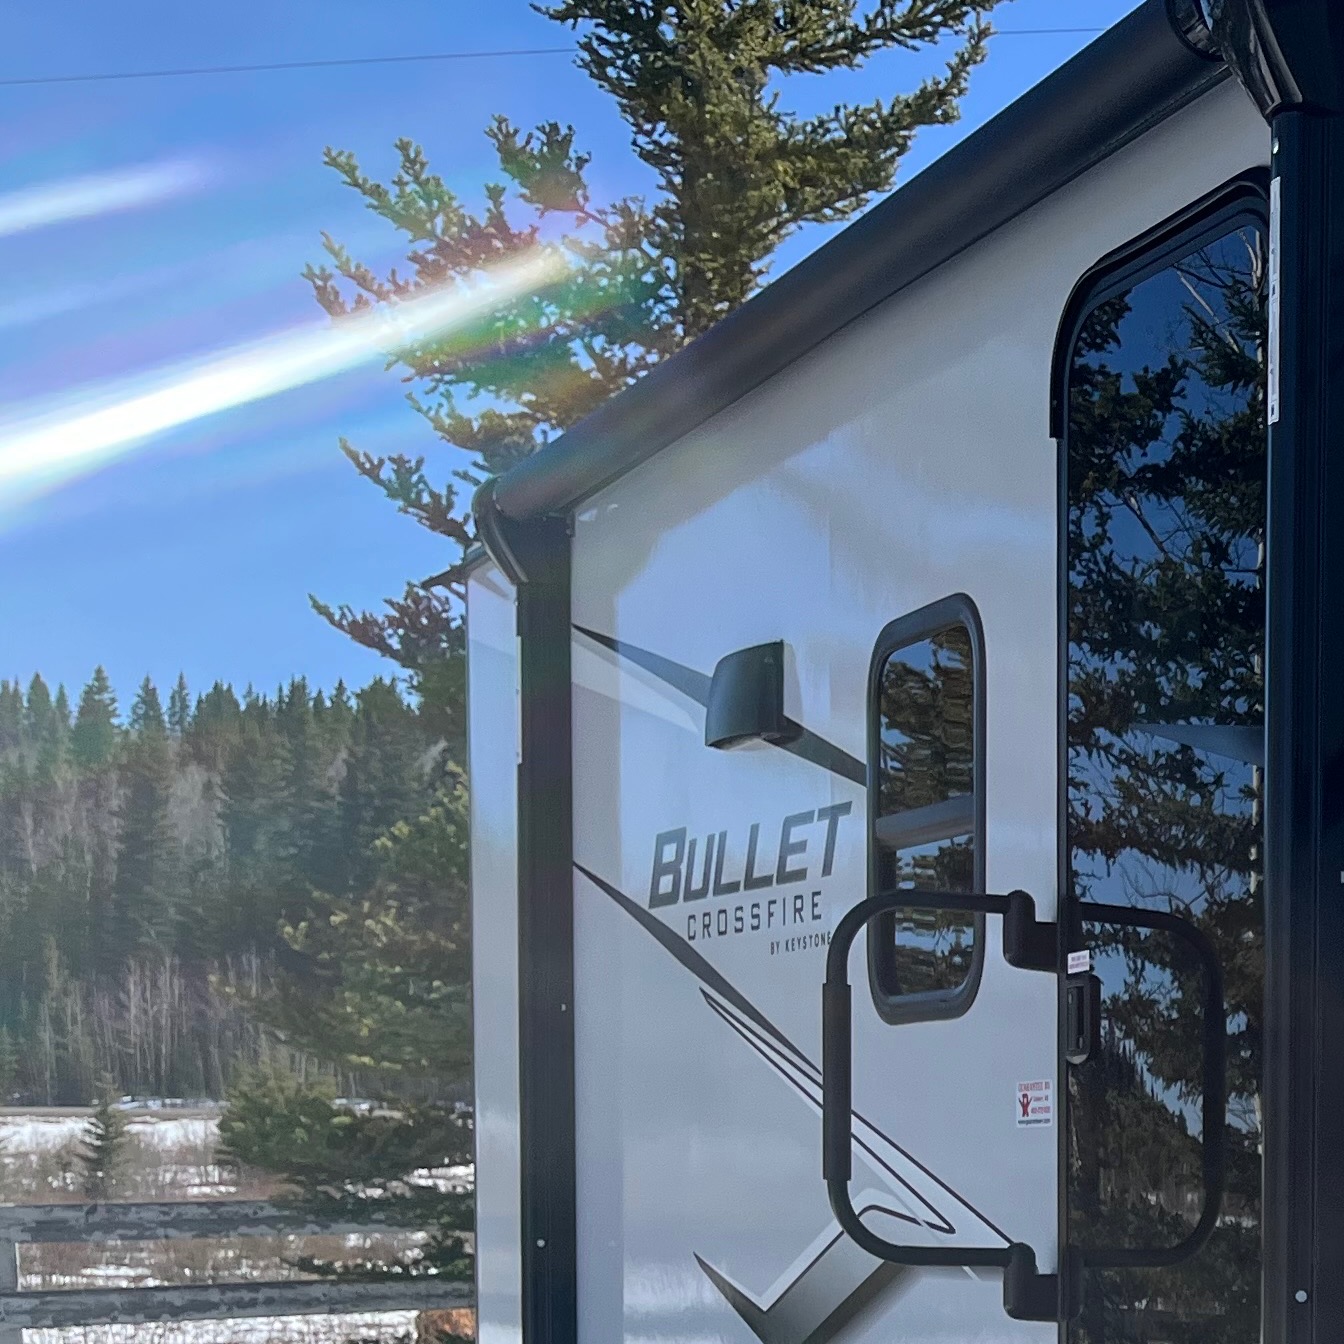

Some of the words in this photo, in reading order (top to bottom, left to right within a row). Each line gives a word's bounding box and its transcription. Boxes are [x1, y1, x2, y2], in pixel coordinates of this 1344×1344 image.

[647, 800, 853, 910] BULLET
[687, 890, 823, 942] CROSSFIRE
[769, 941, 781, 956] BY
[785, 930, 832, 953] KEYSTONE
